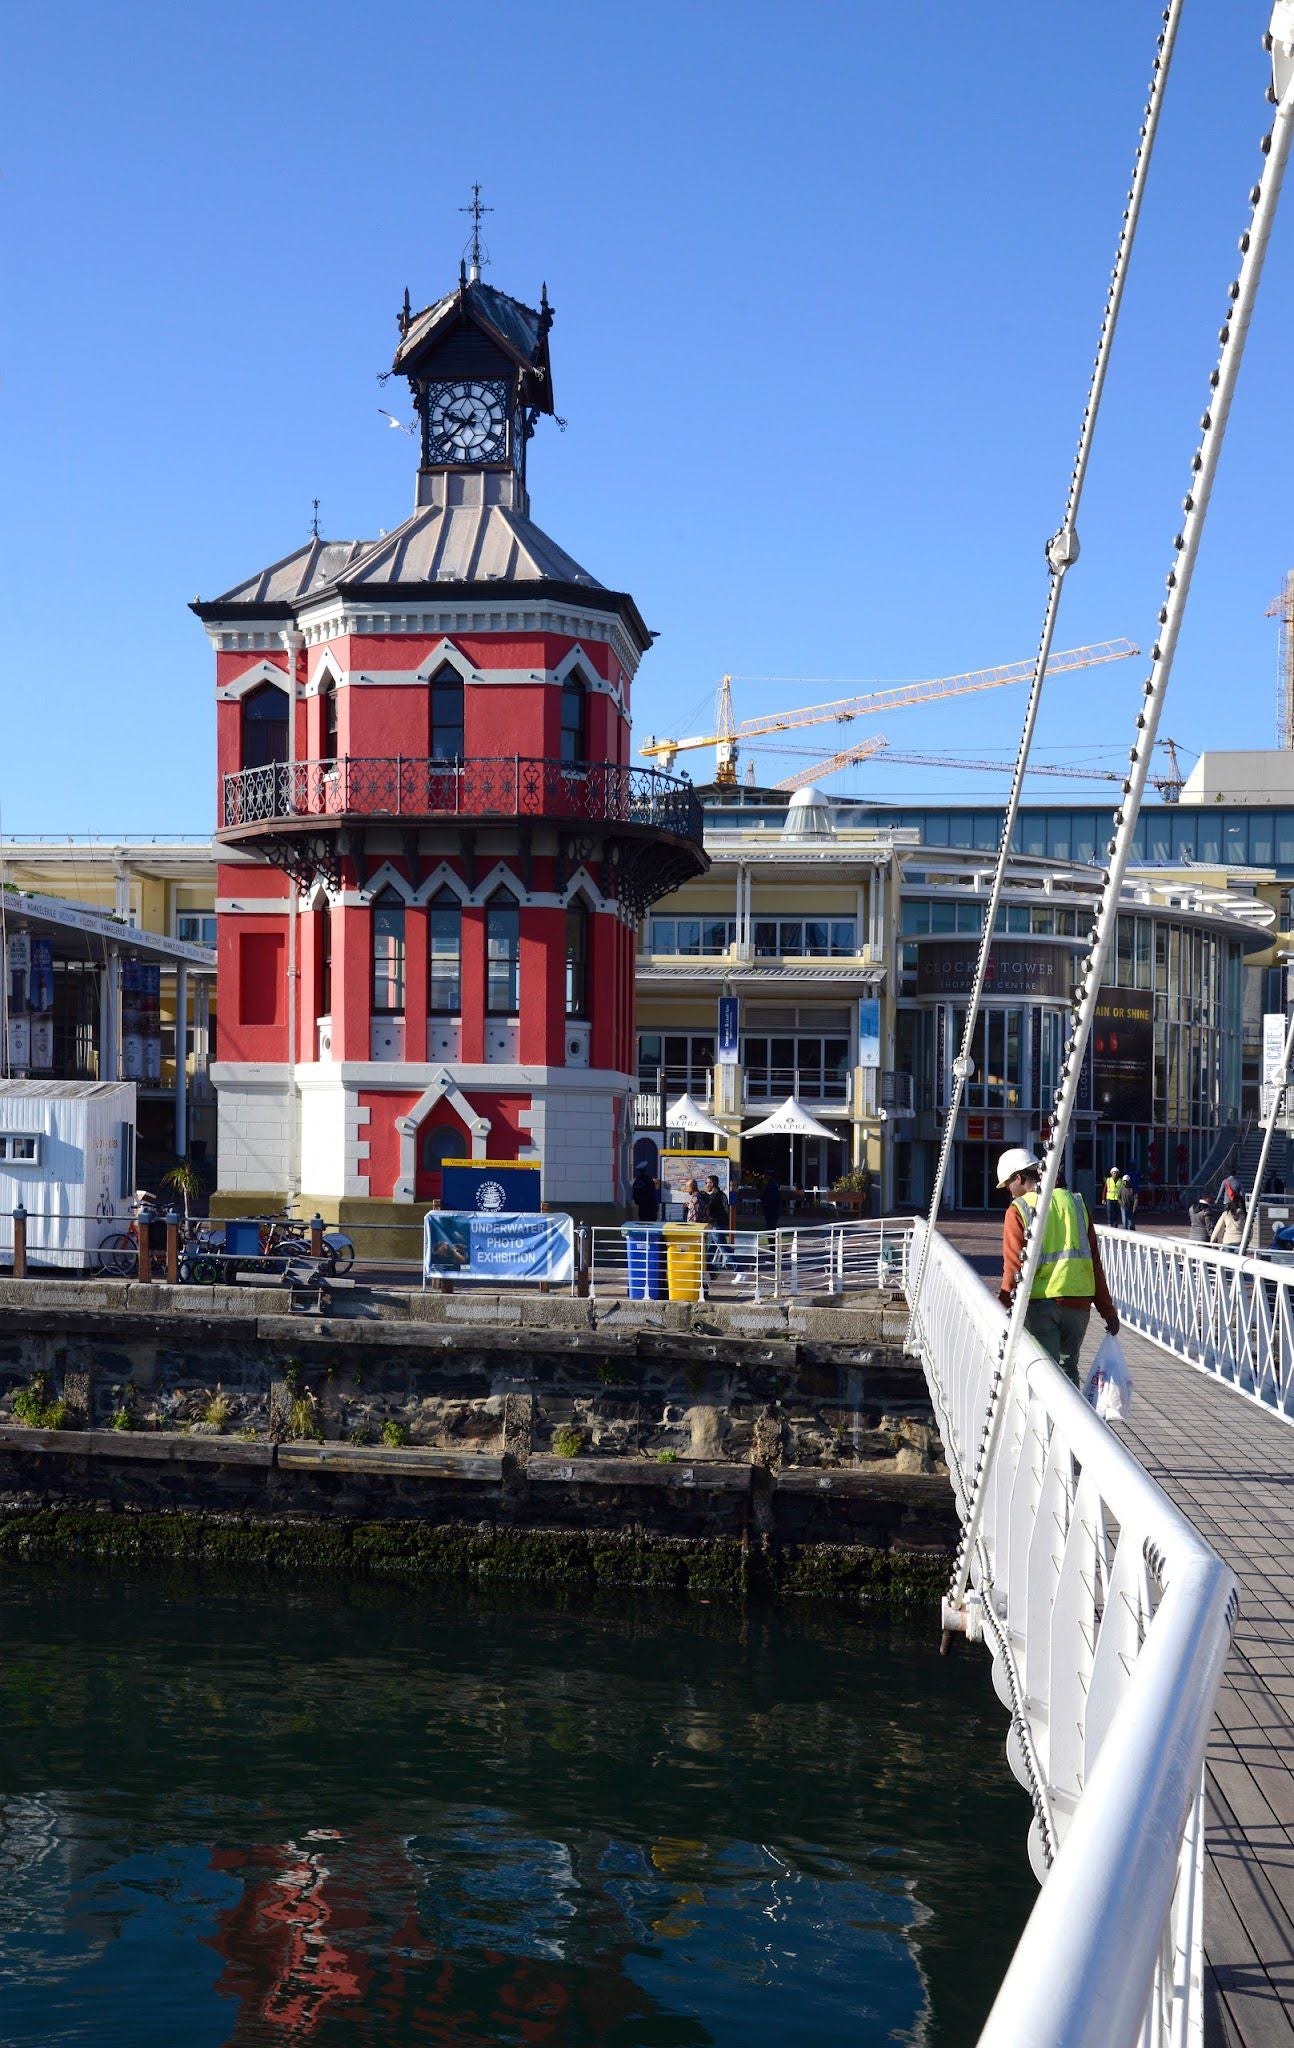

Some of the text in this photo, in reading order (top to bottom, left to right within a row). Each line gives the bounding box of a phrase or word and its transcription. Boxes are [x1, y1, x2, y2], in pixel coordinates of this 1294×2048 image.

[924, 961, 1054, 975] CLOCK TOWER
[939, 981, 1036, 990] SHOPPG CENTRE
[1094, 1006, 1150, 1020] AIN OR SHINE
[471, 1223, 545, 1233] UNDERWATER
[487, 1238, 524, 1248] PHOTO
[477, 1252, 536, 1263] EXHIBITION
